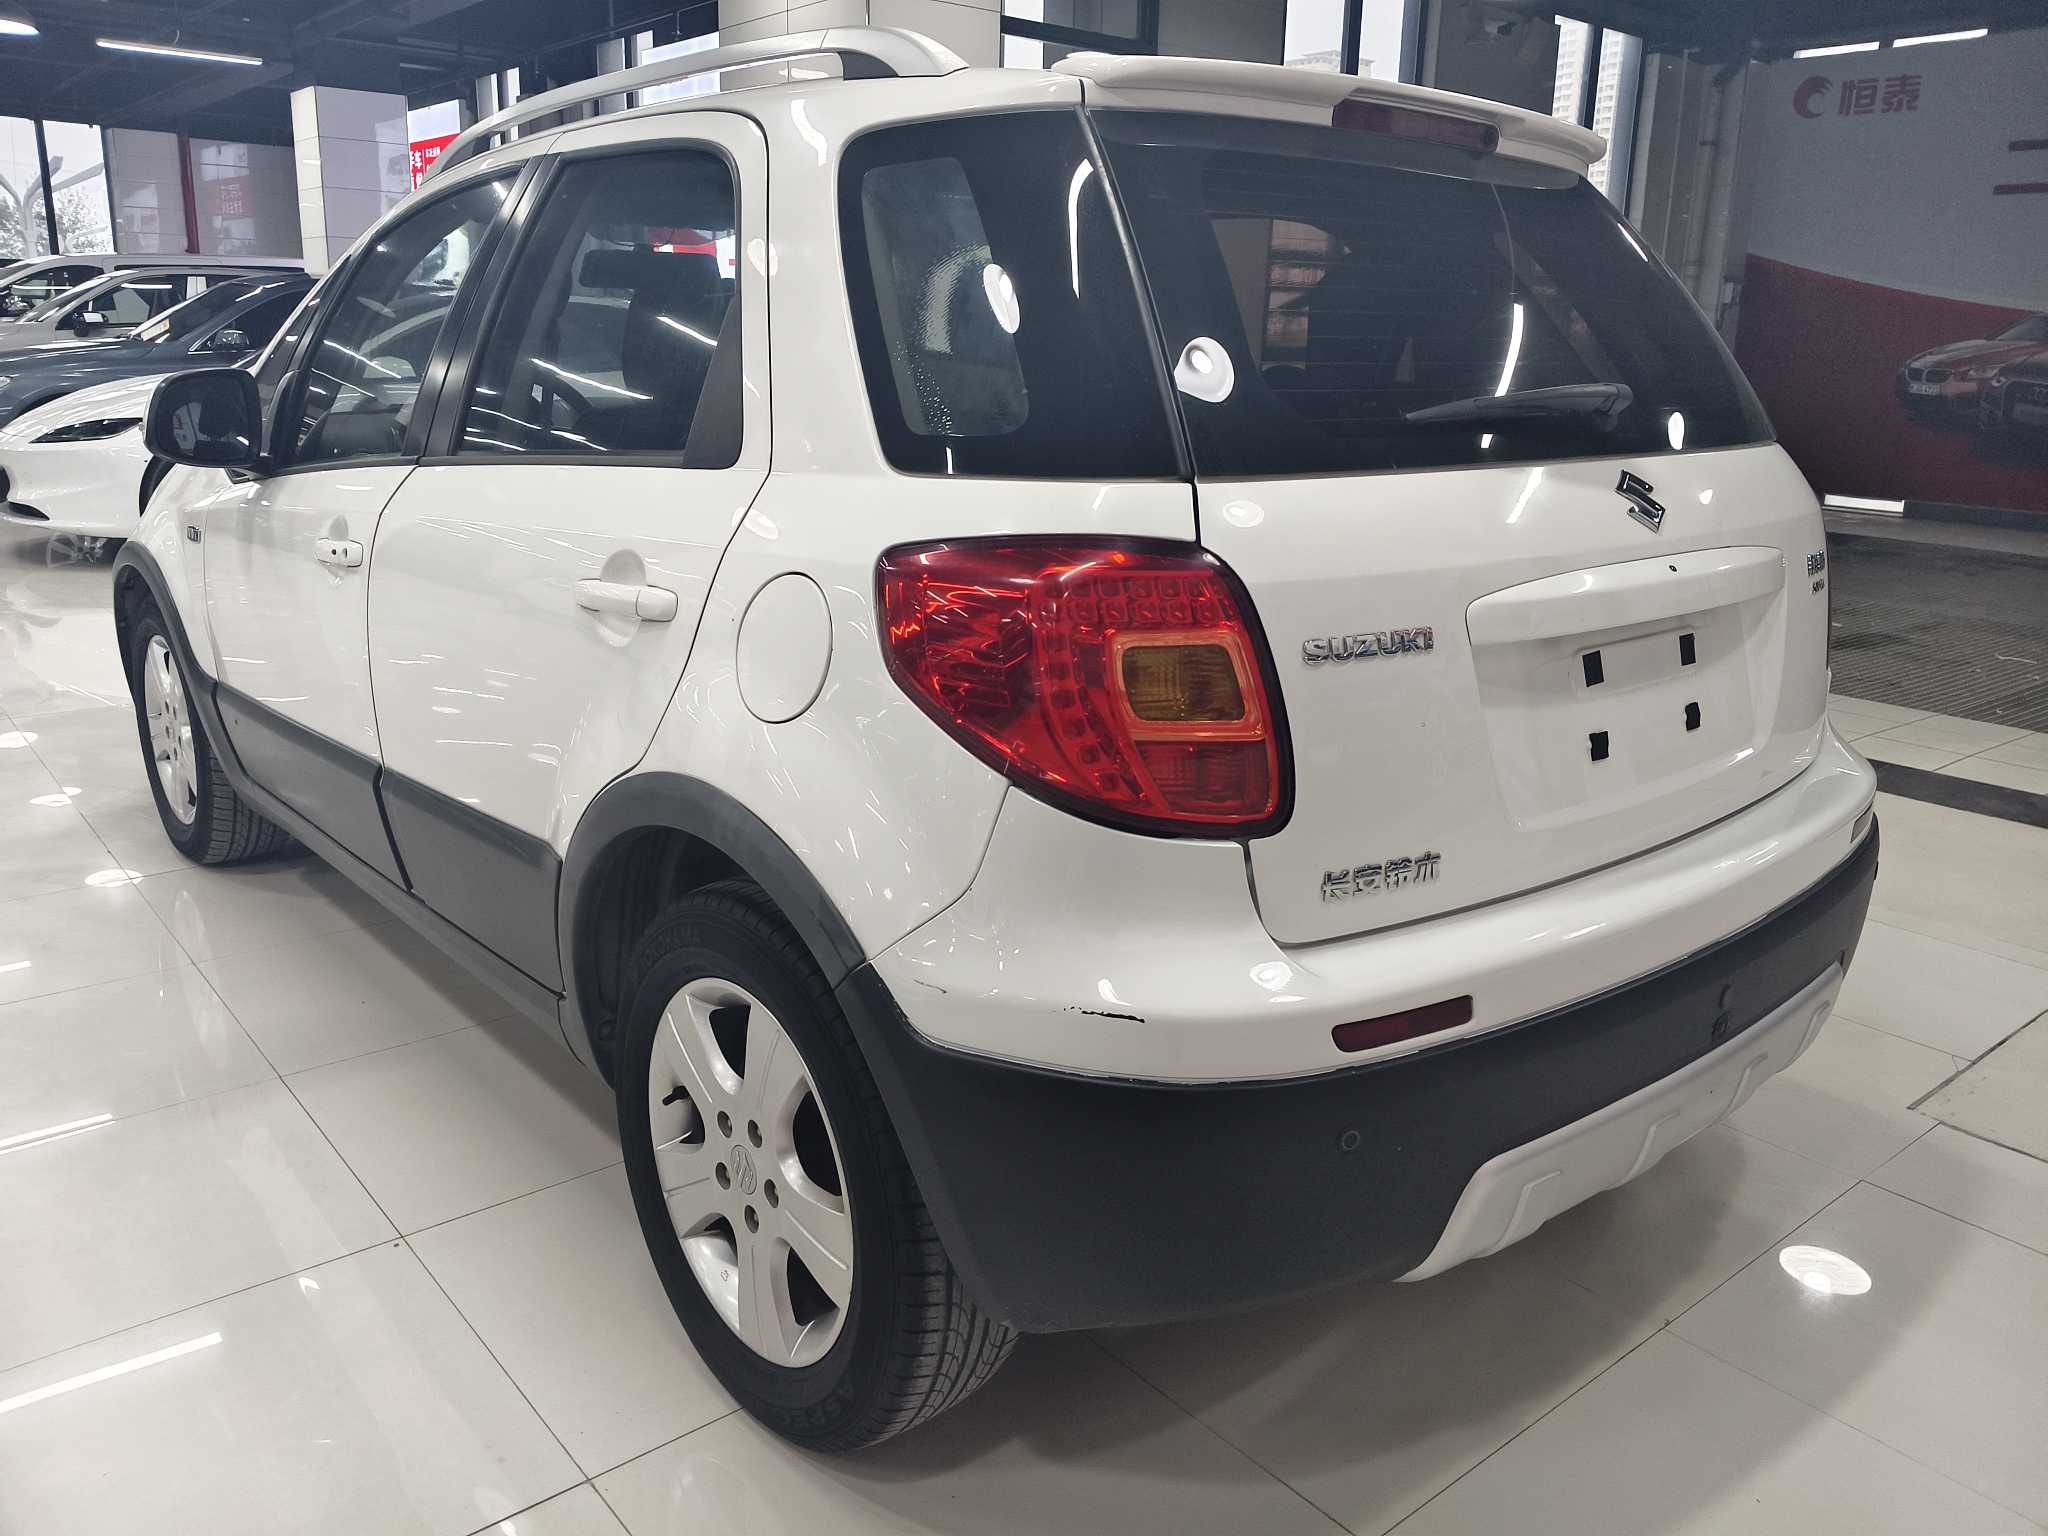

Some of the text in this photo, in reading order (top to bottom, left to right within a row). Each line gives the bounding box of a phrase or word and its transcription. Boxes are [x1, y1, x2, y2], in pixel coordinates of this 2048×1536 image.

[1839, 75, 1923, 116] 恒泰
[1303, 626, 1434, 666] SUZUKI
[1321, 850, 1441, 902] 长安铃木
